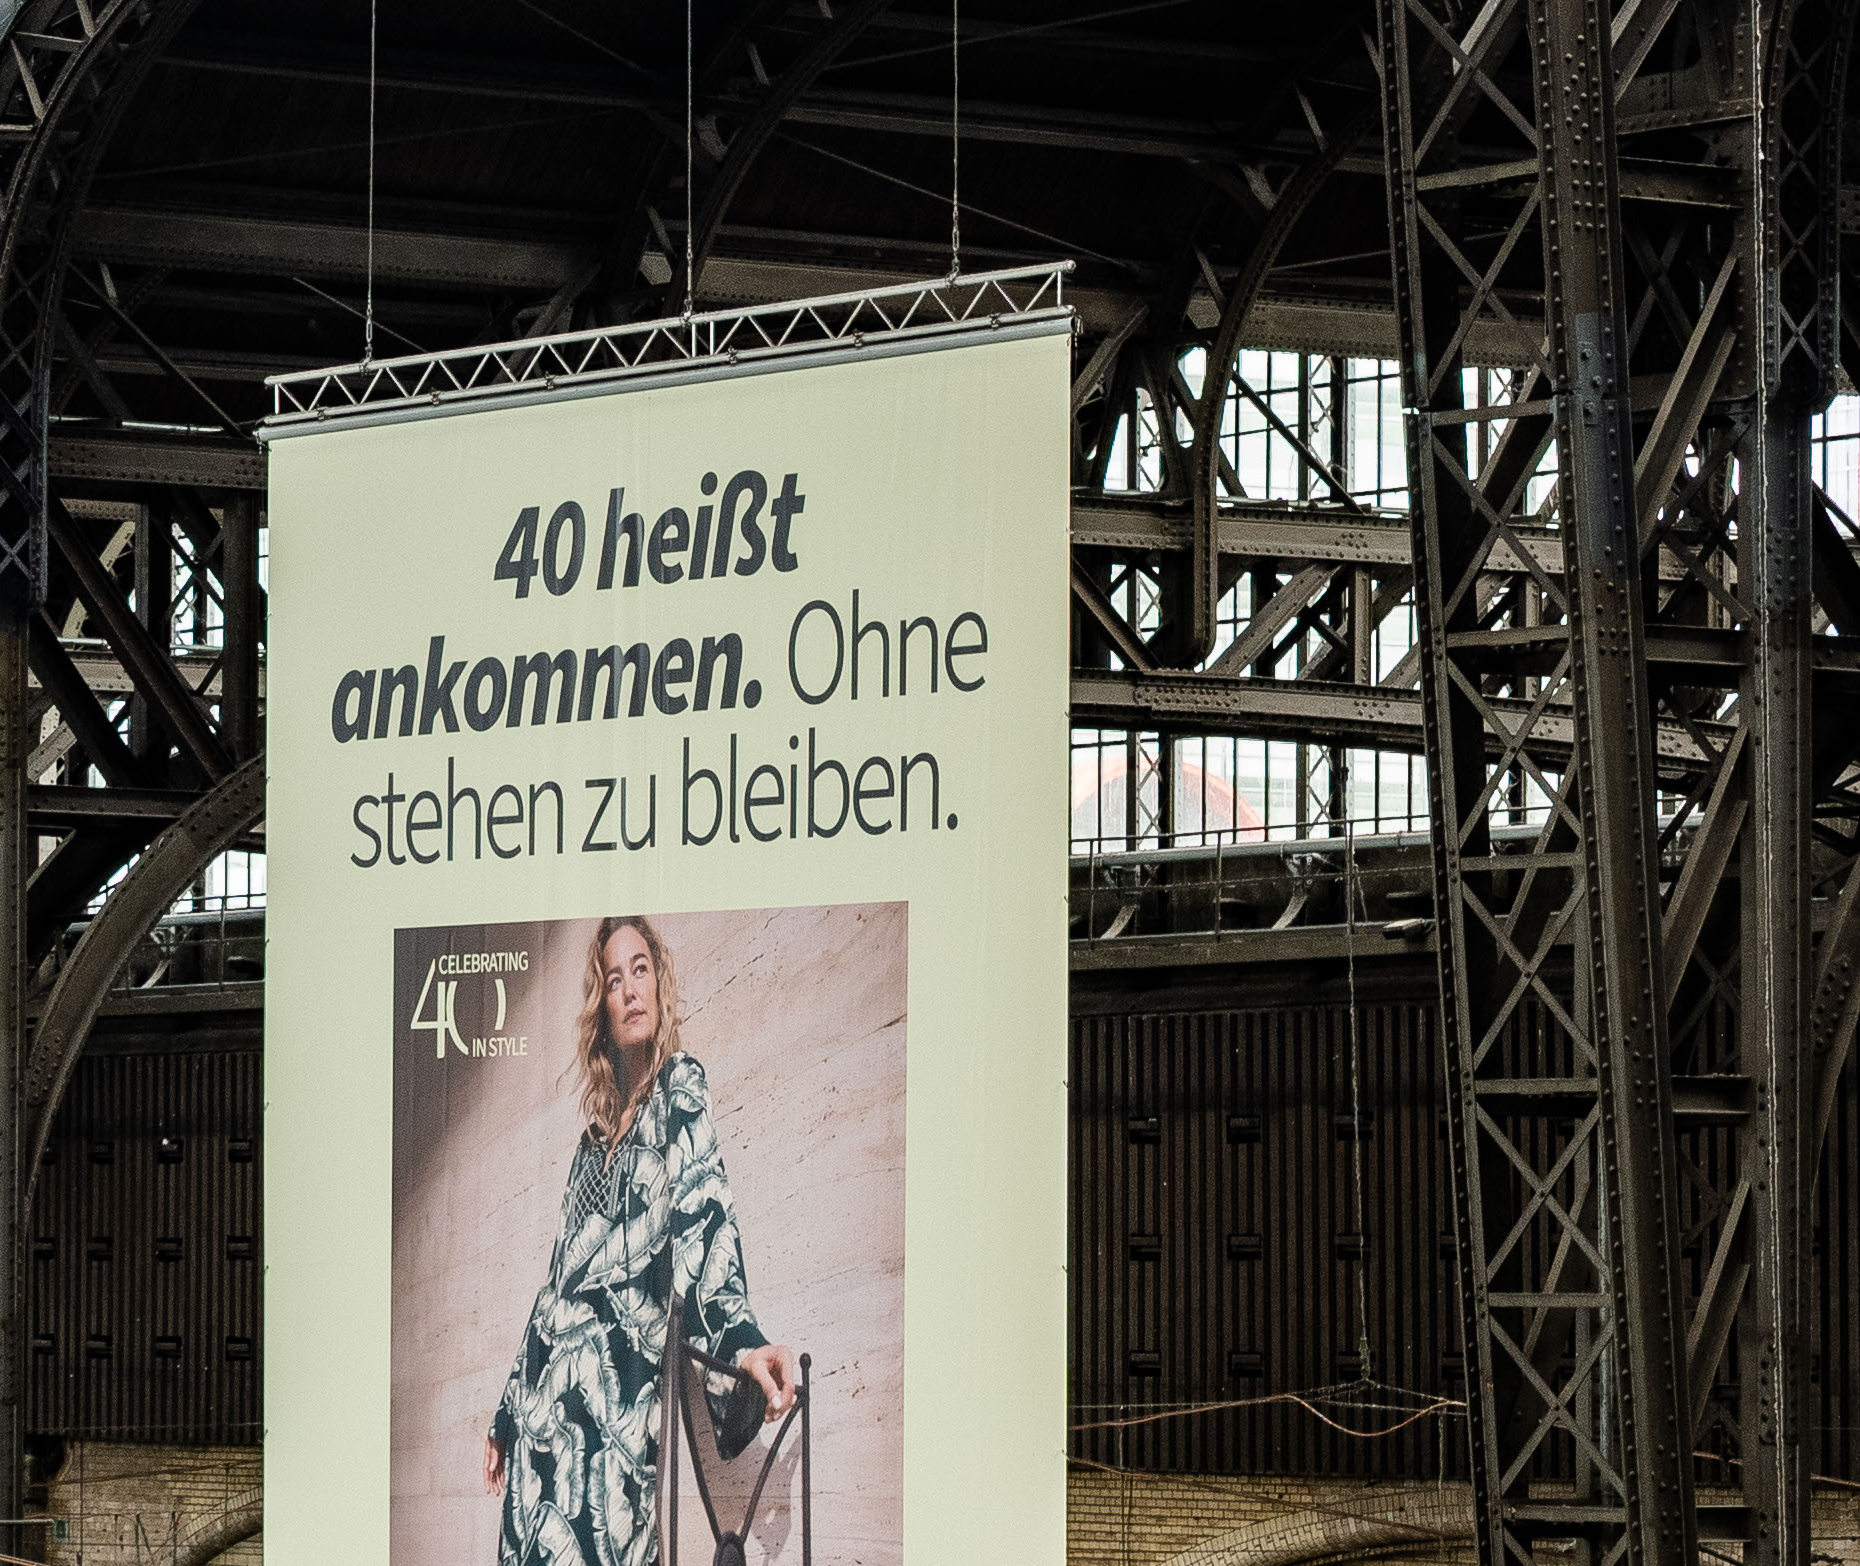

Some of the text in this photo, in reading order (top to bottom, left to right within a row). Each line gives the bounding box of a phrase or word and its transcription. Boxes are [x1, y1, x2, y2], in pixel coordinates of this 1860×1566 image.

[494, 470, 805, 599] 40 heißt
[331, 589, 989, 743] ankommen. Ohne
[350, 727, 959, 868] stehen zu bleiben.
[410, 958, 507, 1059] 40
[439, 951, 529, 975] CELEBRATING
[472, 1036, 528, 1058] IN STYLE
